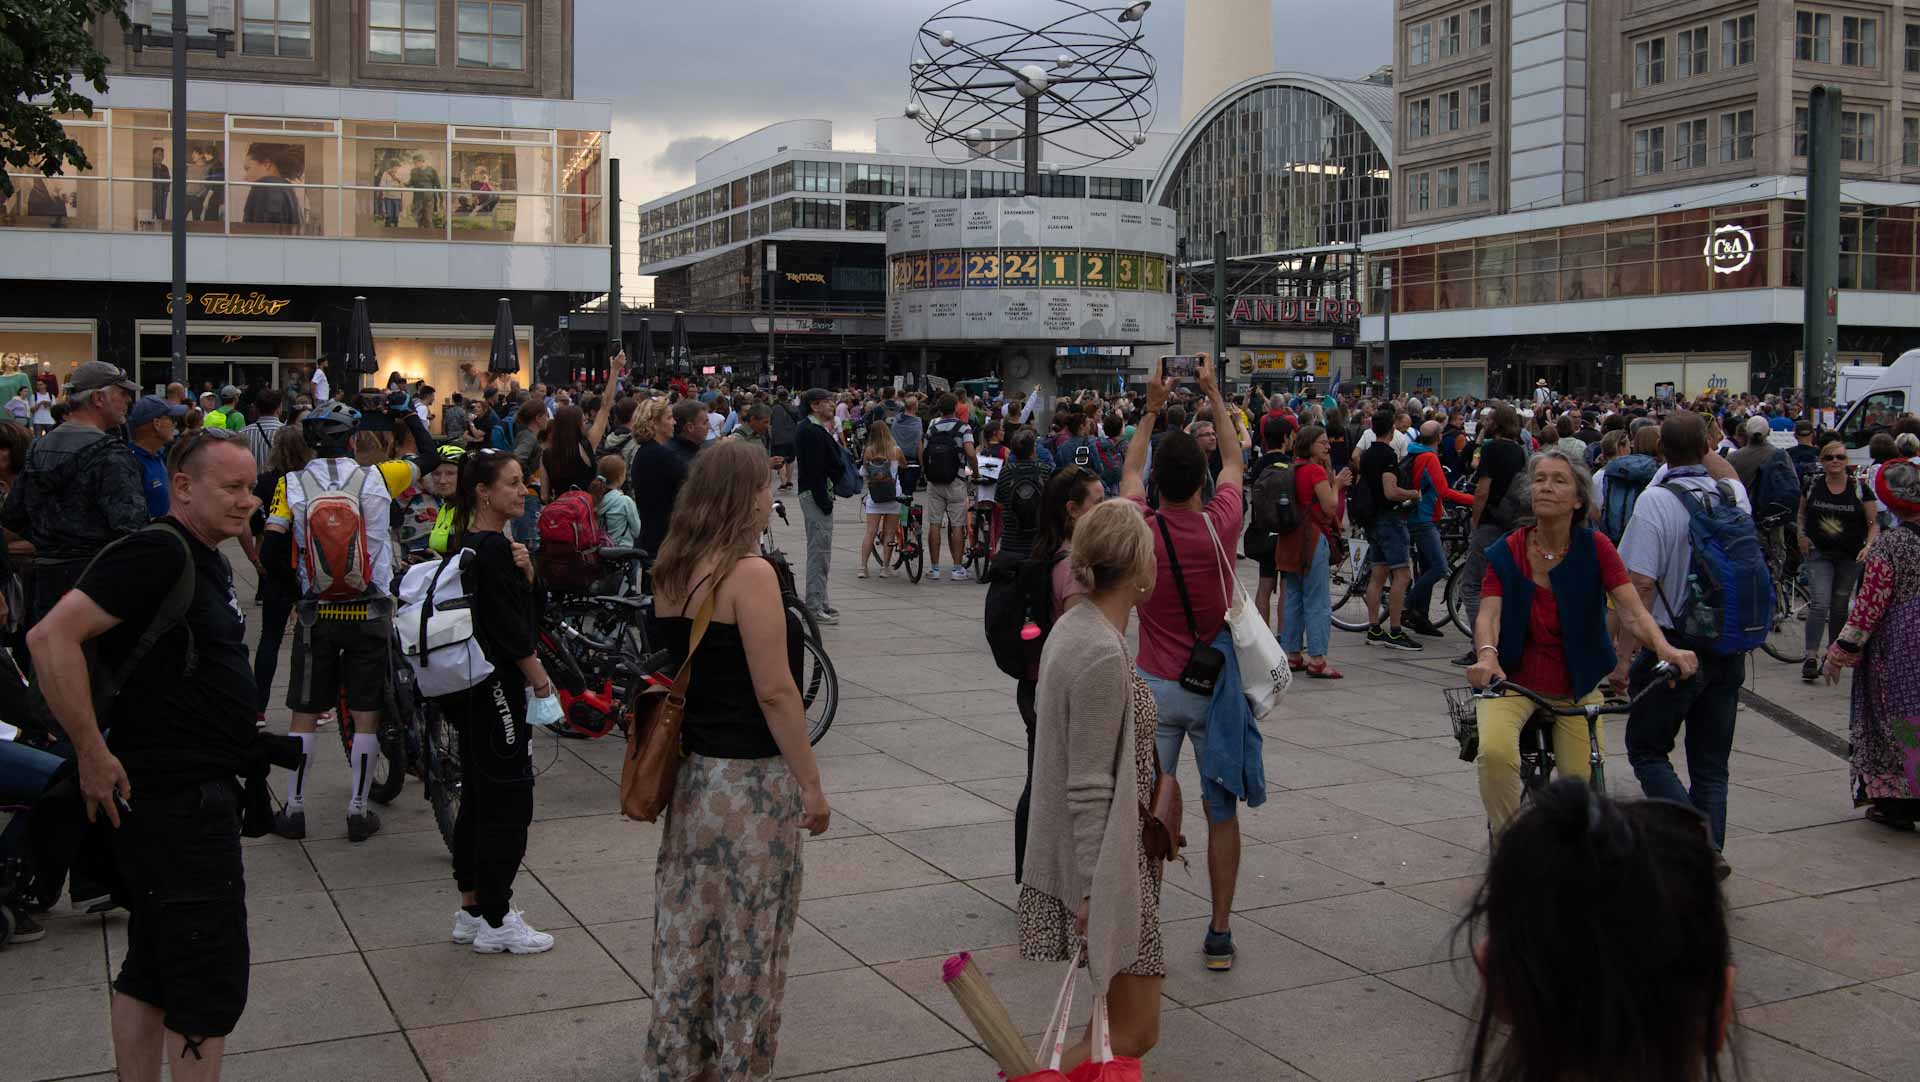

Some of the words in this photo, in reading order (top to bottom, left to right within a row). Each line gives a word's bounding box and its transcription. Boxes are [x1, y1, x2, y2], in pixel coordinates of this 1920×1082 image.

[1714, 237, 1745, 260] C&A
[935, 257, 961, 281] 22
[968, 255, 998, 279] 23
[1004, 255, 1038, 279] 24
[1053, 256, 1065, 279] 1
[1087, 257, 1104, 280] 2
[1119, 259, 1133, 281] 3
[199, 291, 290, 316] Tchibo
[1707, 373, 1727, 388] dm
